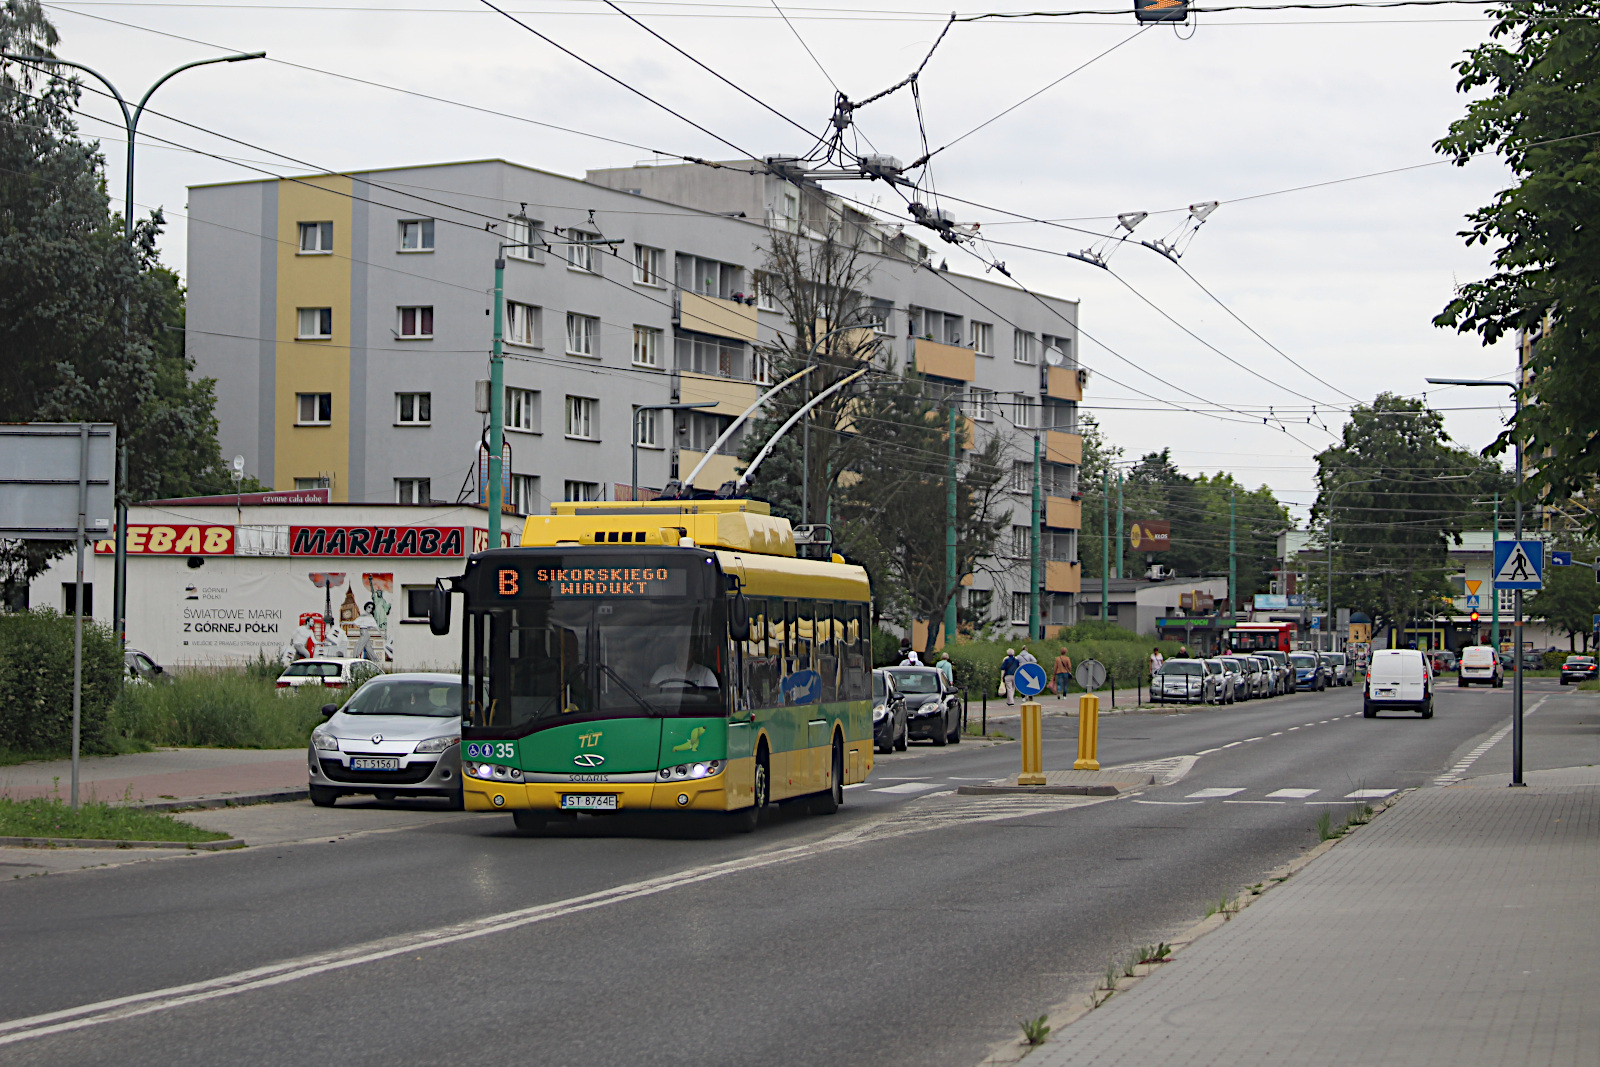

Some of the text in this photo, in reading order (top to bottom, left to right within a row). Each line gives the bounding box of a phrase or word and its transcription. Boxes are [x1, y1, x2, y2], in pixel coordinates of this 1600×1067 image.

[292, 528, 462, 555] MARHABA
[537, 568, 668, 581] SIKORSKIEGO
[498, 569, 519, 595] B
[560, 581, 648, 595] WIADUKT
[183, 607, 282, 619] ŚWIATOWE MARKI
[183, 621, 278, 633] Z GÓRNEJ PÓŁKI
[579, 732, 602, 748] TLT
[495, 743, 514, 758] 35
[356, 760, 396, 769] ST 5156J
[569, 774, 609, 782] SOLARIS
[568, 796, 615, 806] ST 8764E
